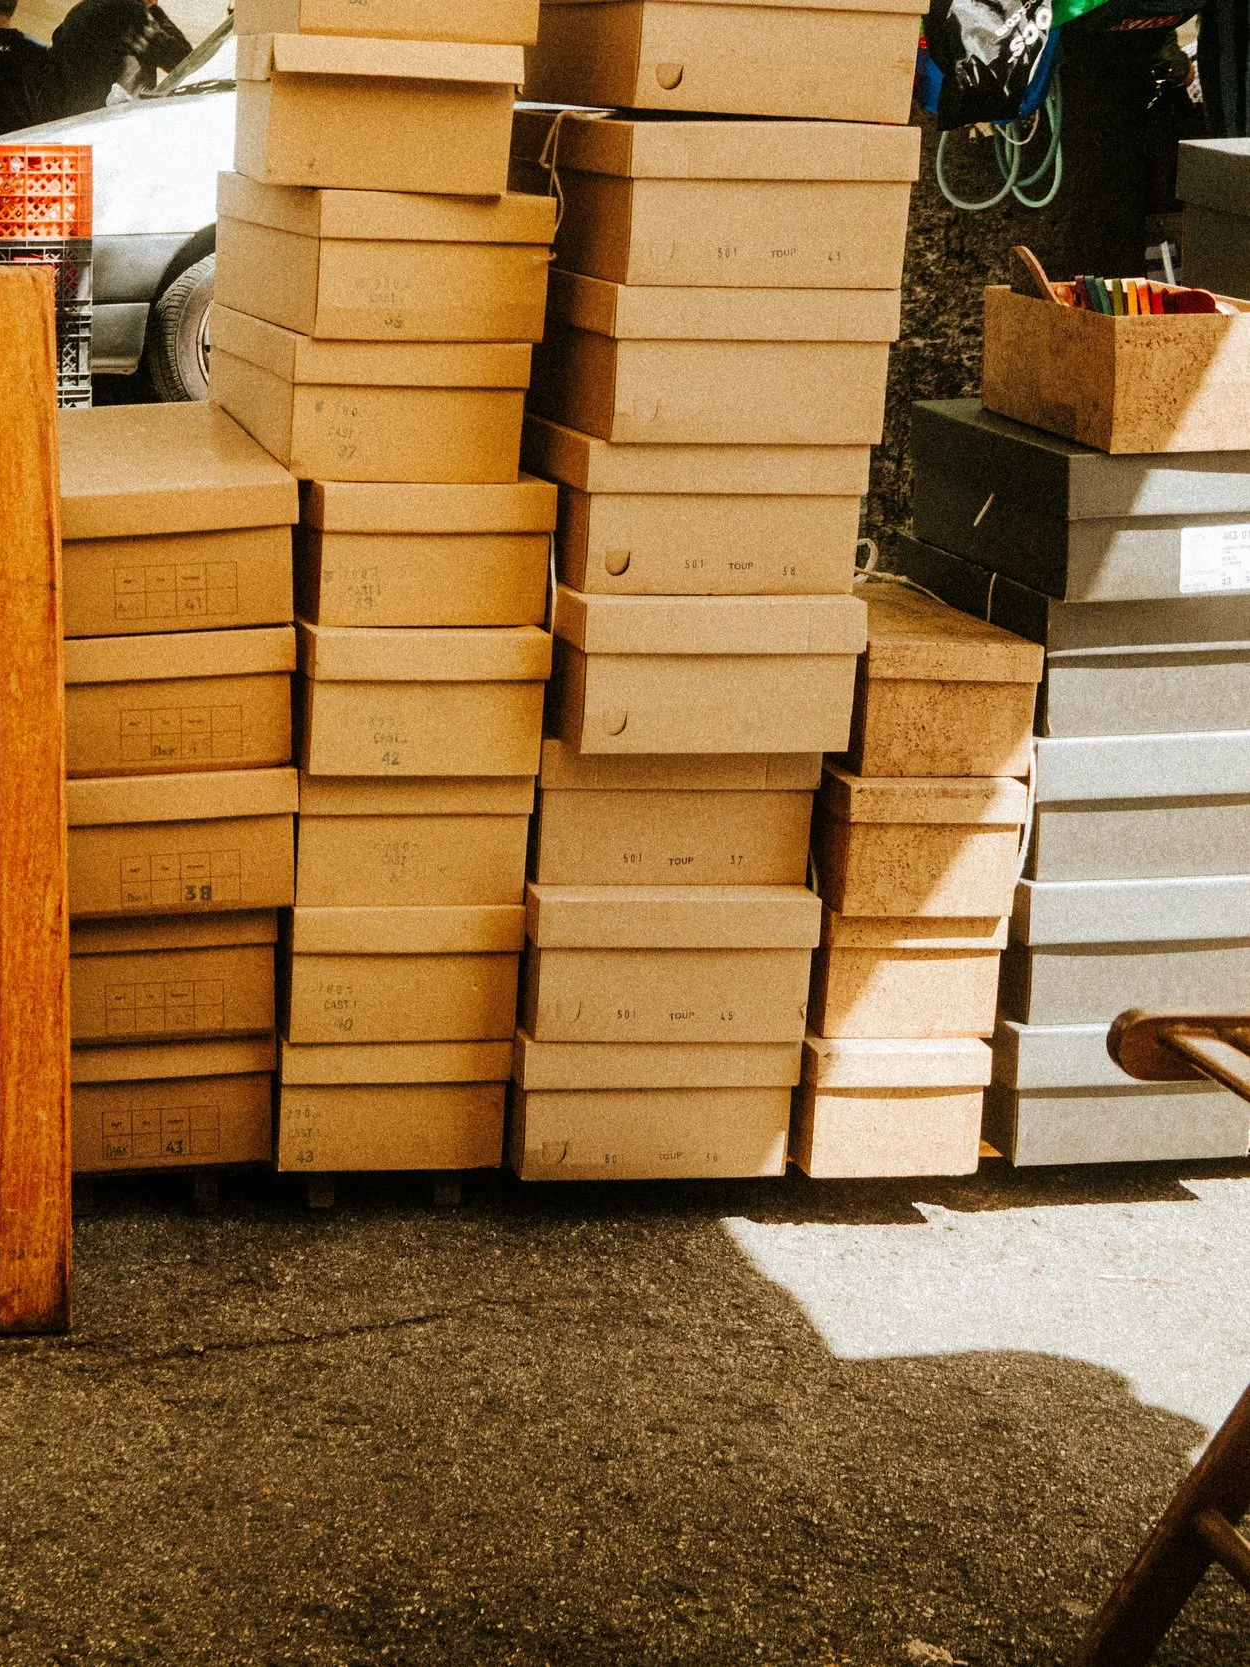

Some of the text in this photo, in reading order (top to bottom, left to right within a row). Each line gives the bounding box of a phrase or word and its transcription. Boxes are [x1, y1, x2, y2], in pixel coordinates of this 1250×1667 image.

[717, 246, 738, 259] 501
[771, 248, 797, 259] TOUP
[684, 559, 704, 569] 501
[728, 561, 754, 571] TOUP
[622, 852, 744, 867] 501 TOUP 37
[185, 885, 212, 902] 38
[617, 1009, 637, 1019] 501
[669, 1011, 696, 1021] TOUP
[166, 1140, 184, 1154] 43
